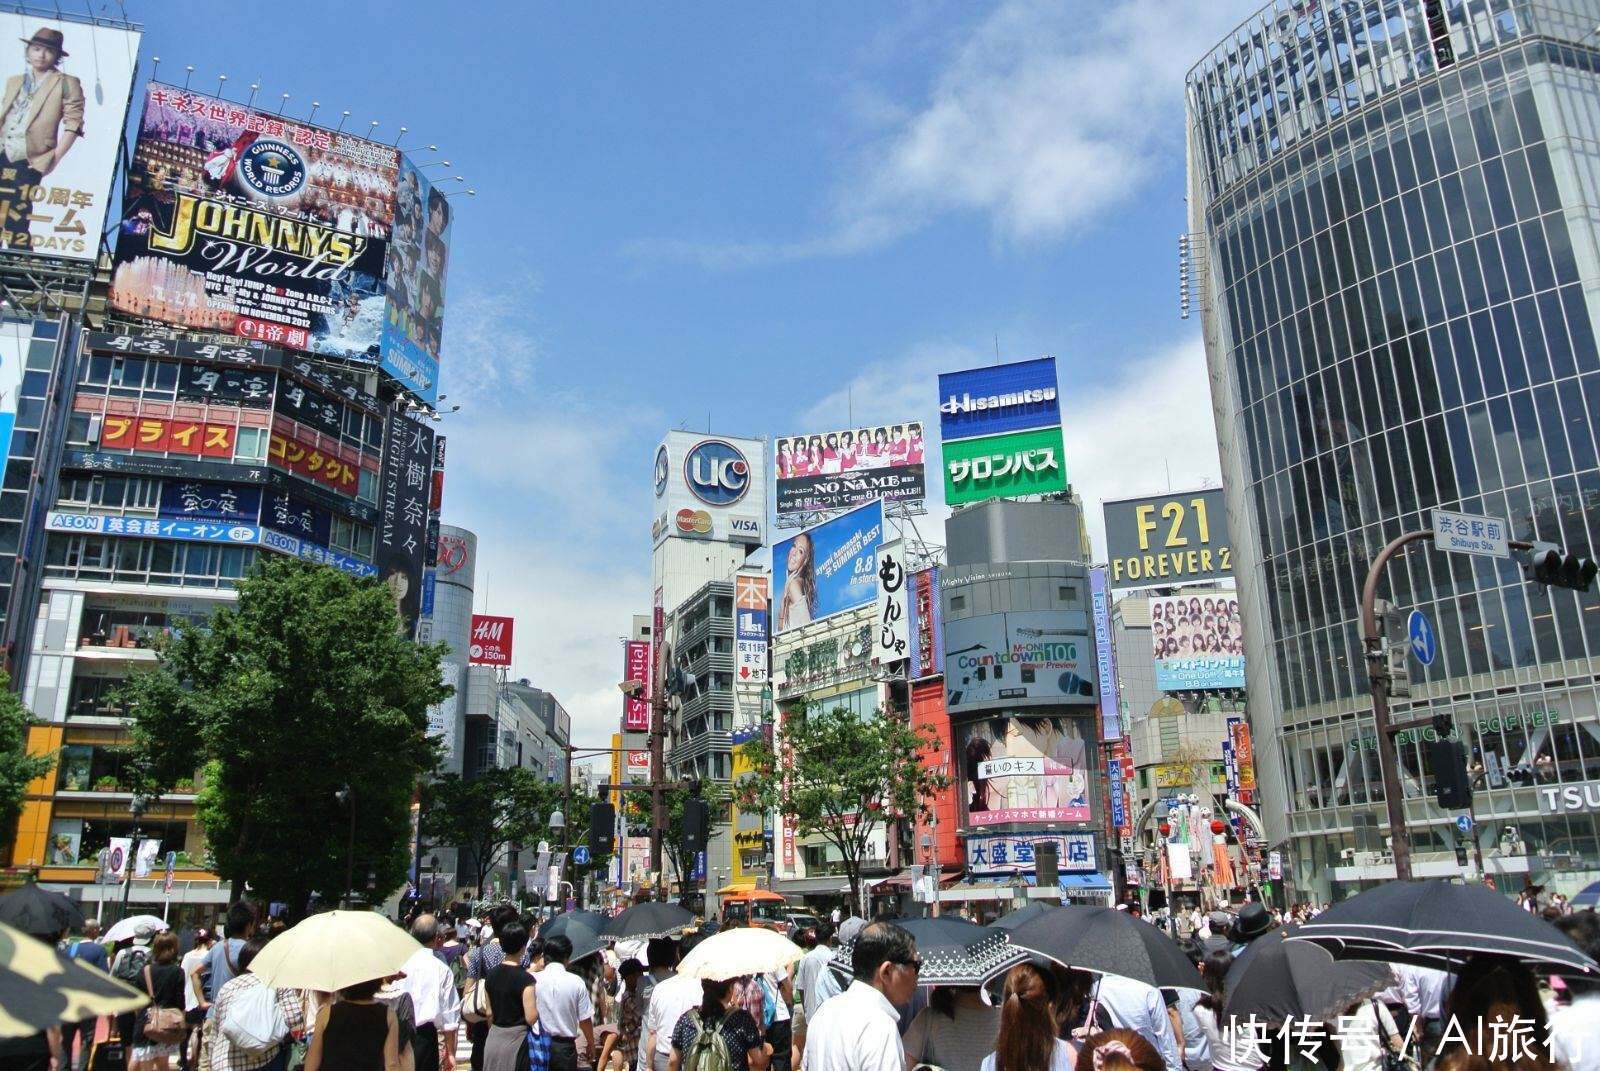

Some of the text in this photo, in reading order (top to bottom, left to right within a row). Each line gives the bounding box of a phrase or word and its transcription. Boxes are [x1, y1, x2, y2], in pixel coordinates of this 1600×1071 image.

[294, 126, 331, 151] 認定
[251, 142, 300, 166] GUINNESS
[243, 158, 303, 195] WORLD RECORDS
[150, 194, 365, 264] JOHNNYS'
[202, 240, 363, 282] World
[243, 280, 265, 291] JUMP
[207, 299, 240, 314] OPENING
[240, 305, 250, 315] IN
[250, 307, 291, 323] NOVEMBER
[291, 316, 311, 328] 2012
[298, 300, 311, 311] ALL
[311, 303, 336, 315] STARS
[940, 387, 1056, 414] Hisamitsu
[105, 418, 230, 449] プライス
[269, 433, 355, 485] コンタクト
[948, 446, 1059, 483] サロンパス
[249, 470, 260, 479] 7F
[814, 481, 840, 495] NO
[843, 475, 900, 492] NAME
[400, 427, 429, 555] 水樹奈々
[52, 514, 99, 530] AEON
[108, 518, 250, 539] 英会話イーオン 6F
[731, 520, 758, 531] VISA
[1135, 498, 1210, 550] F21
[1439, 516, 1501, 540] 渋谷駅前
[265, 531, 296, 552] AEON
[862, 524, 880, 546] BEST
[1450, 536, 1495, 551] Shibuya Sta.
[302, 543, 377, 576] 英会話イーオン
[854, 555, 874, 574] 8.8
[1113, 547, 1232, 581] FOREVER 2
[964, 573, 986, 584] Vision
[737, 577, 768, 609] 本
[879, 554, 906, 656] もんじゃ
[473, 620, 505, 642] H&M
[484, 651, 506, 661] 150m
[738, 642, 766, 653] 夜11時
[744, 653, 761, 664] まで
[958, 643, 1078, 669] Countdown 100
[752, 668, 766, 680] 地下
[1046, 661, 1078, 669] Preview
[627, 643, 644, 727] Esntial
[1350, 709, 1560, 752] STABUCS COFFEE
[1542, 784, 1600, 812] TSU
[972, 840, 1089, 866] 大盛堂店
